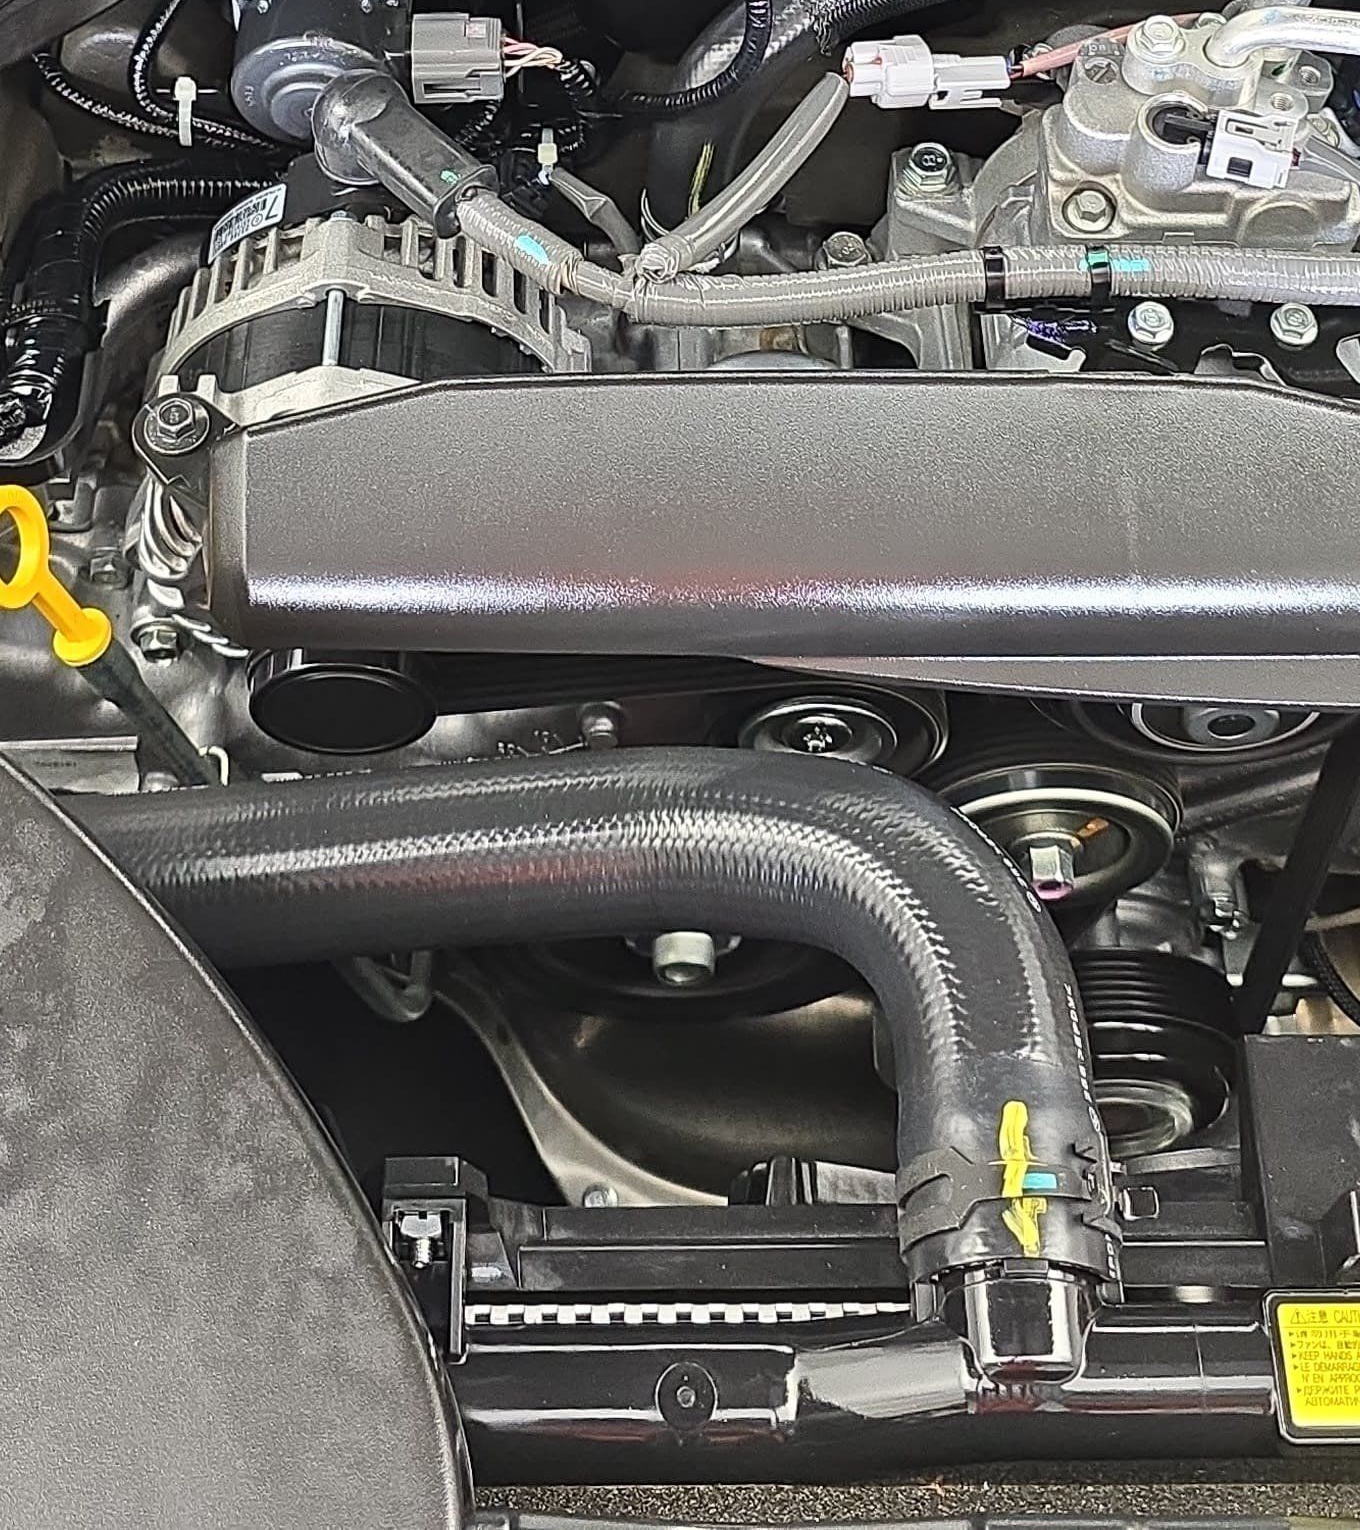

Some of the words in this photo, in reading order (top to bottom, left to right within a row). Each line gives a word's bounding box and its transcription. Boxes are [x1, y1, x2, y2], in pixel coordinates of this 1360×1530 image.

[1299, 1350, 1320, 1361] KEEP
[1323, 1350, 1353, 1361] HANDS
[1300, 1362, 1310, 1372] LE
